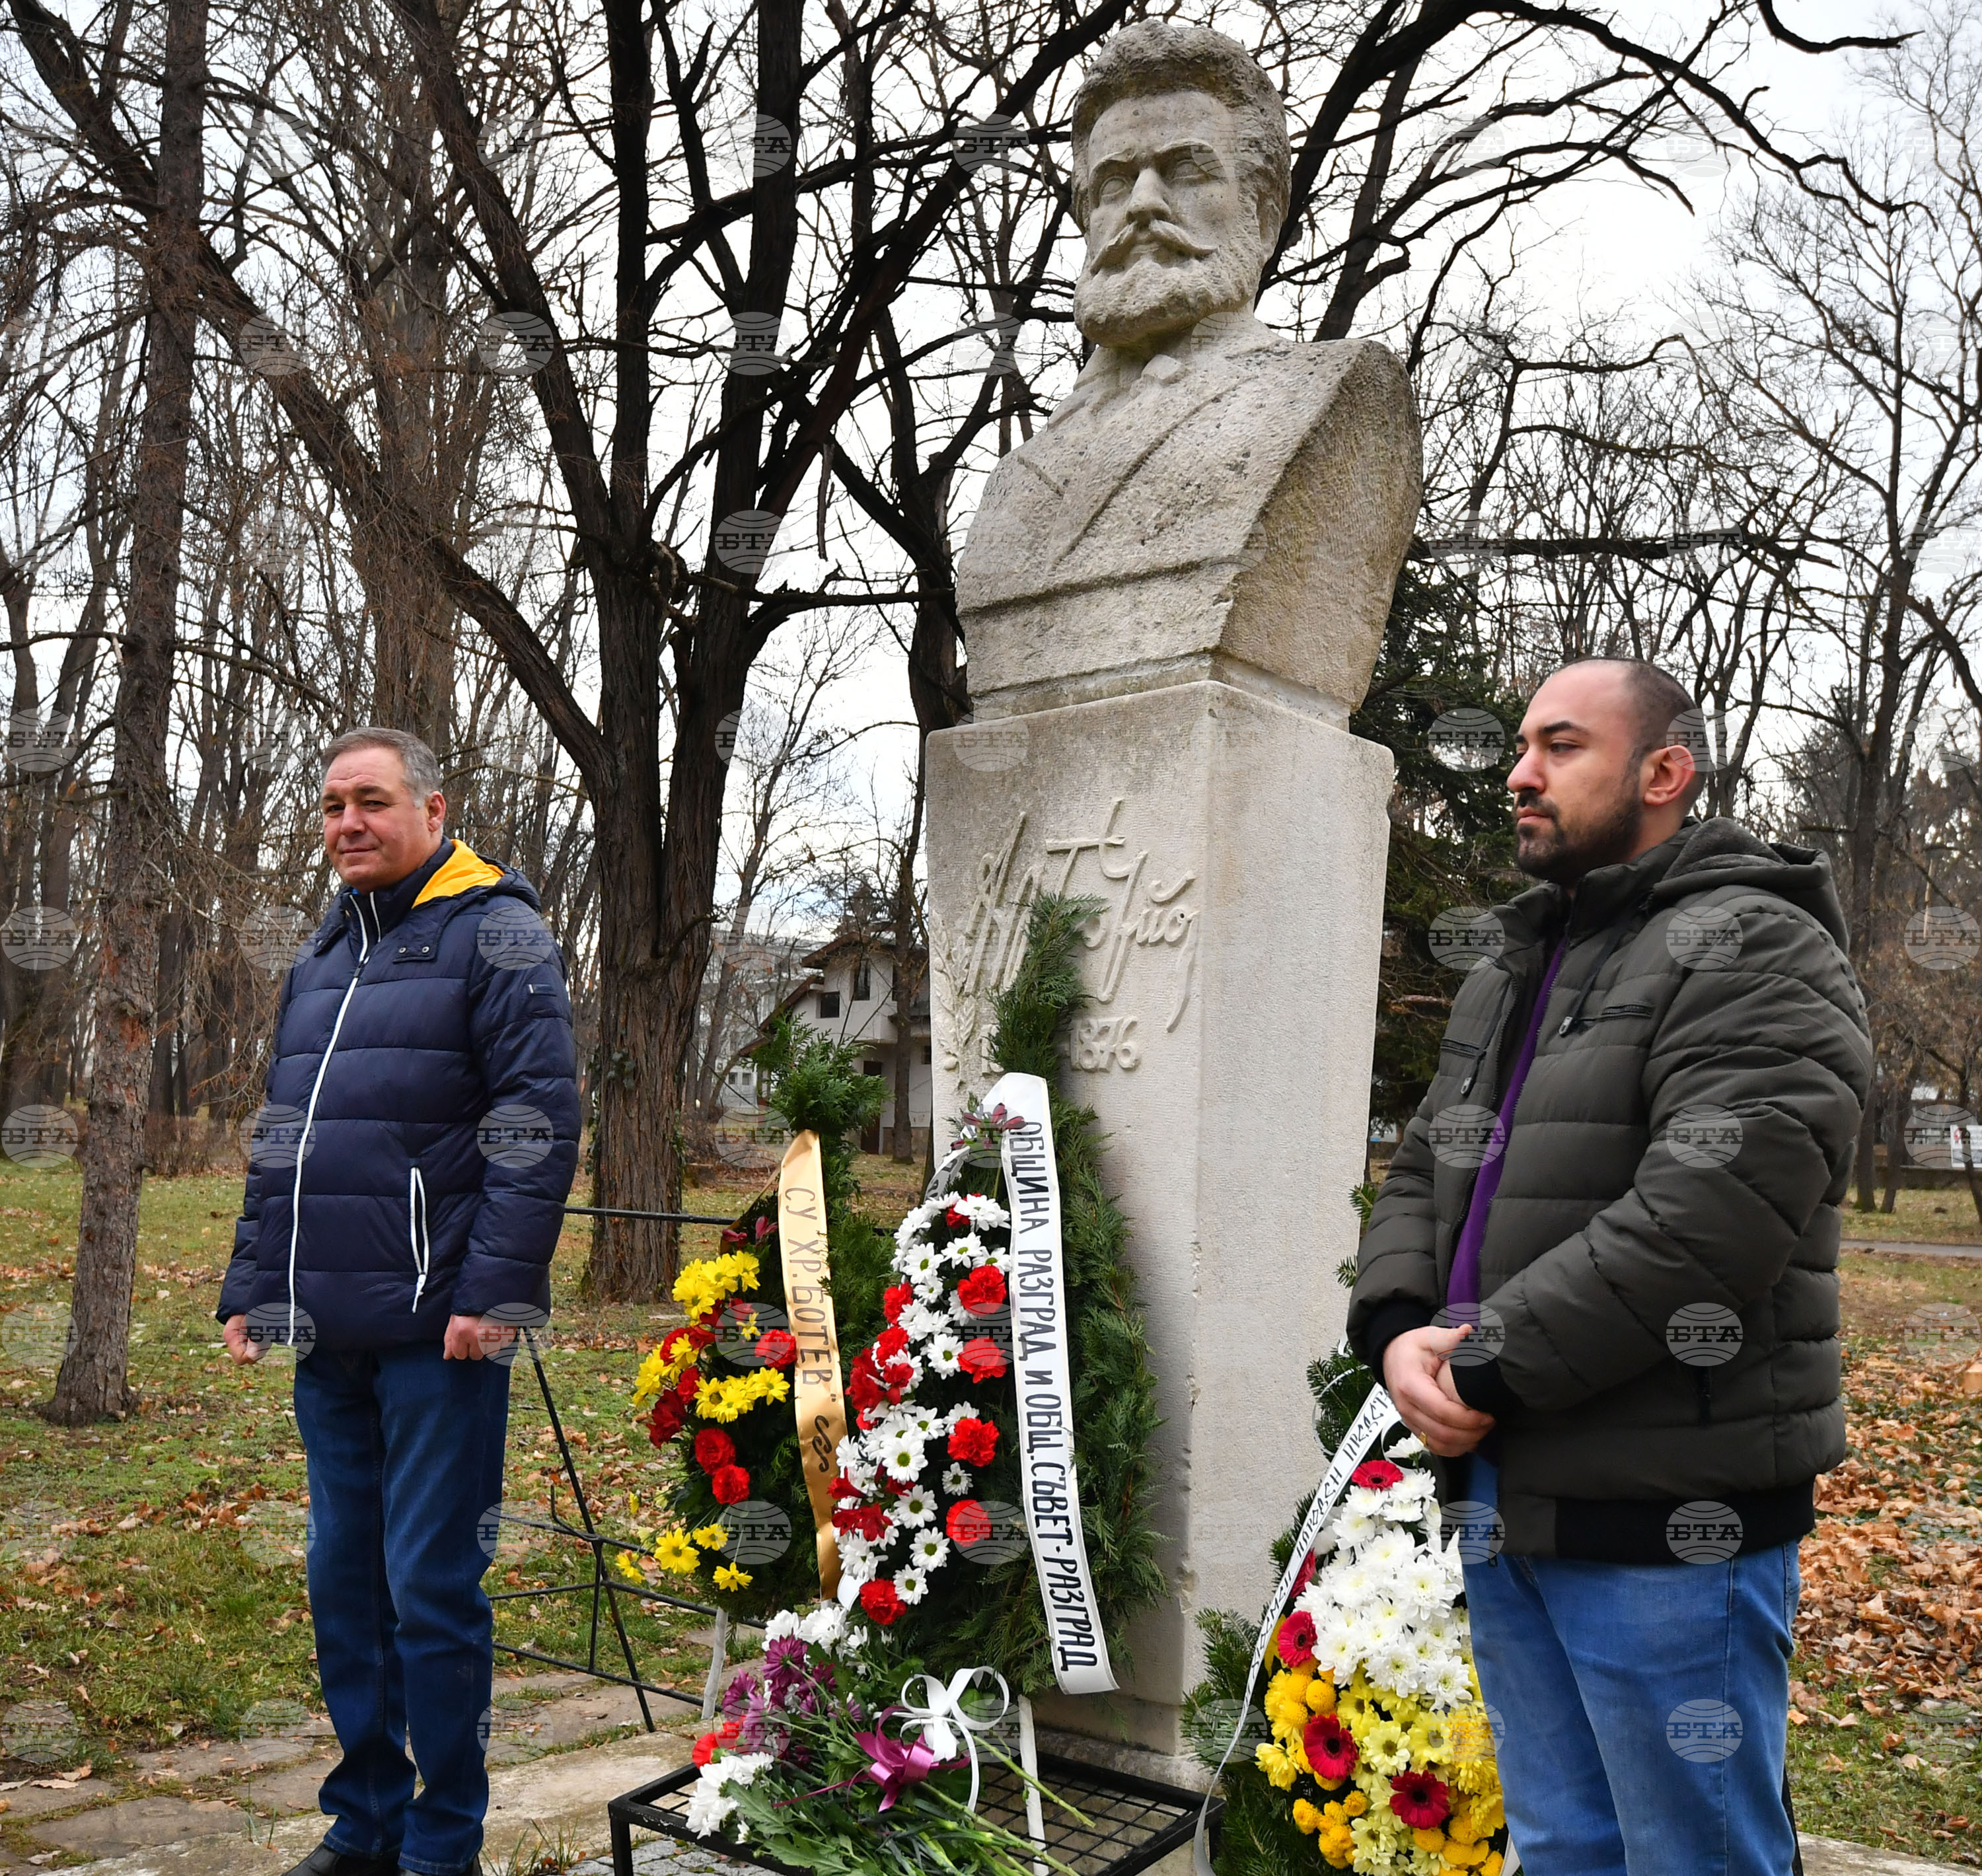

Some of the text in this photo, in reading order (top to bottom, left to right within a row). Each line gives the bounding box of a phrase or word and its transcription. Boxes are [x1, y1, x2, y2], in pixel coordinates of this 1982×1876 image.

[785, 1188, 818, 1221] СУ
[1008, 1122, 1050, 1234] ОБЩИНА
[1017, 1250, 1057, 1361] РАЗГРАД
[1025, 1370, 1053, 1385] И
[1043, 1556, 1097, 1672] РАЗГРАД
